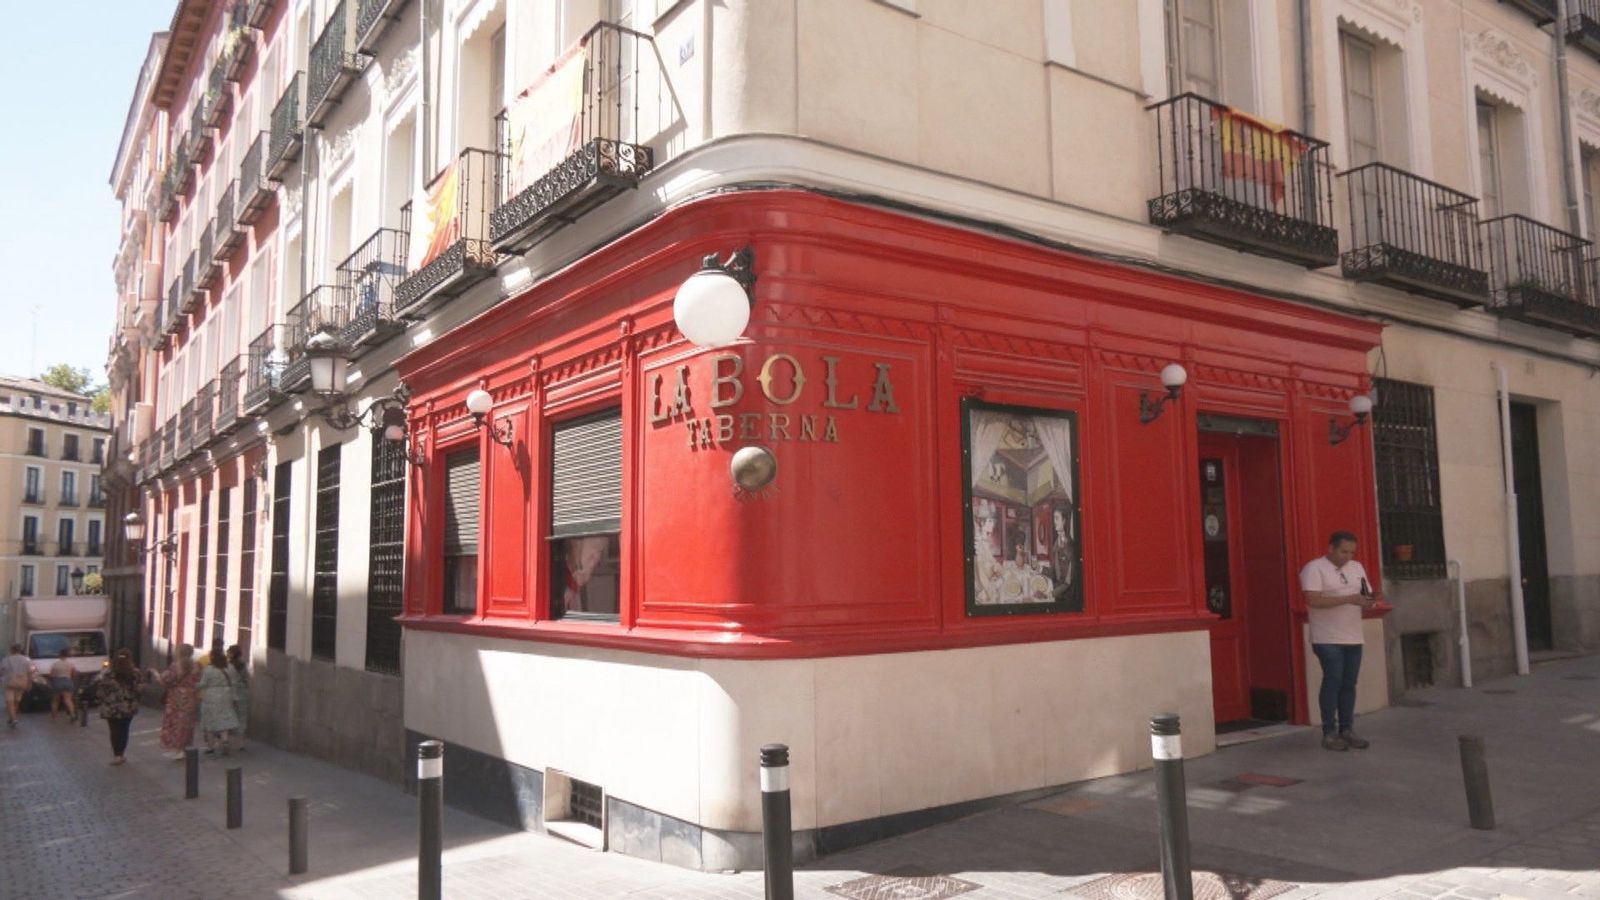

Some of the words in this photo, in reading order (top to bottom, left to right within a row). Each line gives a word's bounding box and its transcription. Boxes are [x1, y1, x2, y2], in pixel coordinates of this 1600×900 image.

[649, 365, 691, 423] LA
[710, 353, 899, 413] BOLA
[686, 413, 840, 451] TABERNA
